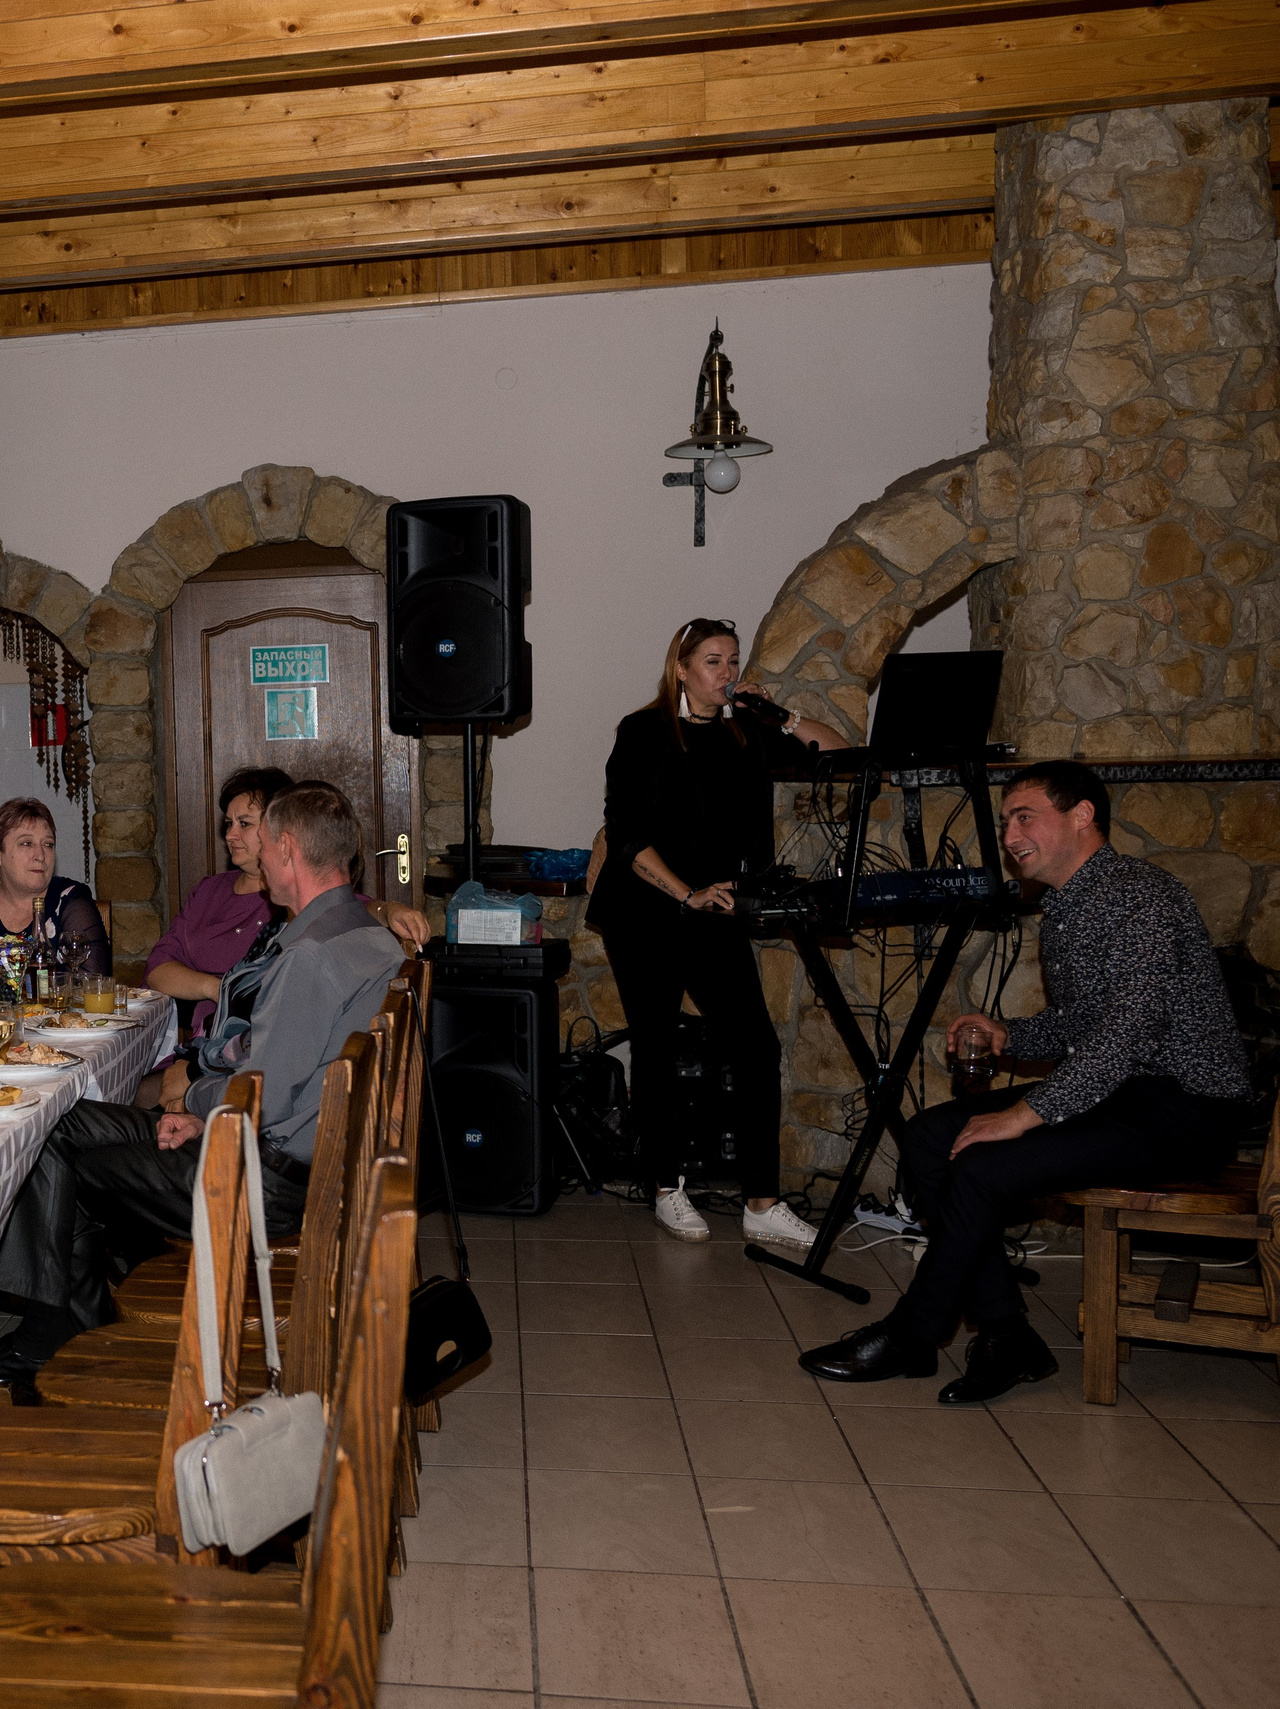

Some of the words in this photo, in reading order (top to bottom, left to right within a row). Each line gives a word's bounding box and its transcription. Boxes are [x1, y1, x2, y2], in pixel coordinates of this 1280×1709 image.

[255, 648, 322, 661] ЗАПАСНЫЙ
[439, 643, 455, 653] RCF
[255, 660, 324, 678] ВЫХОД
[935, 874, 988, 889] Soundcra
[465, 1133, 482, 1143] RCF
